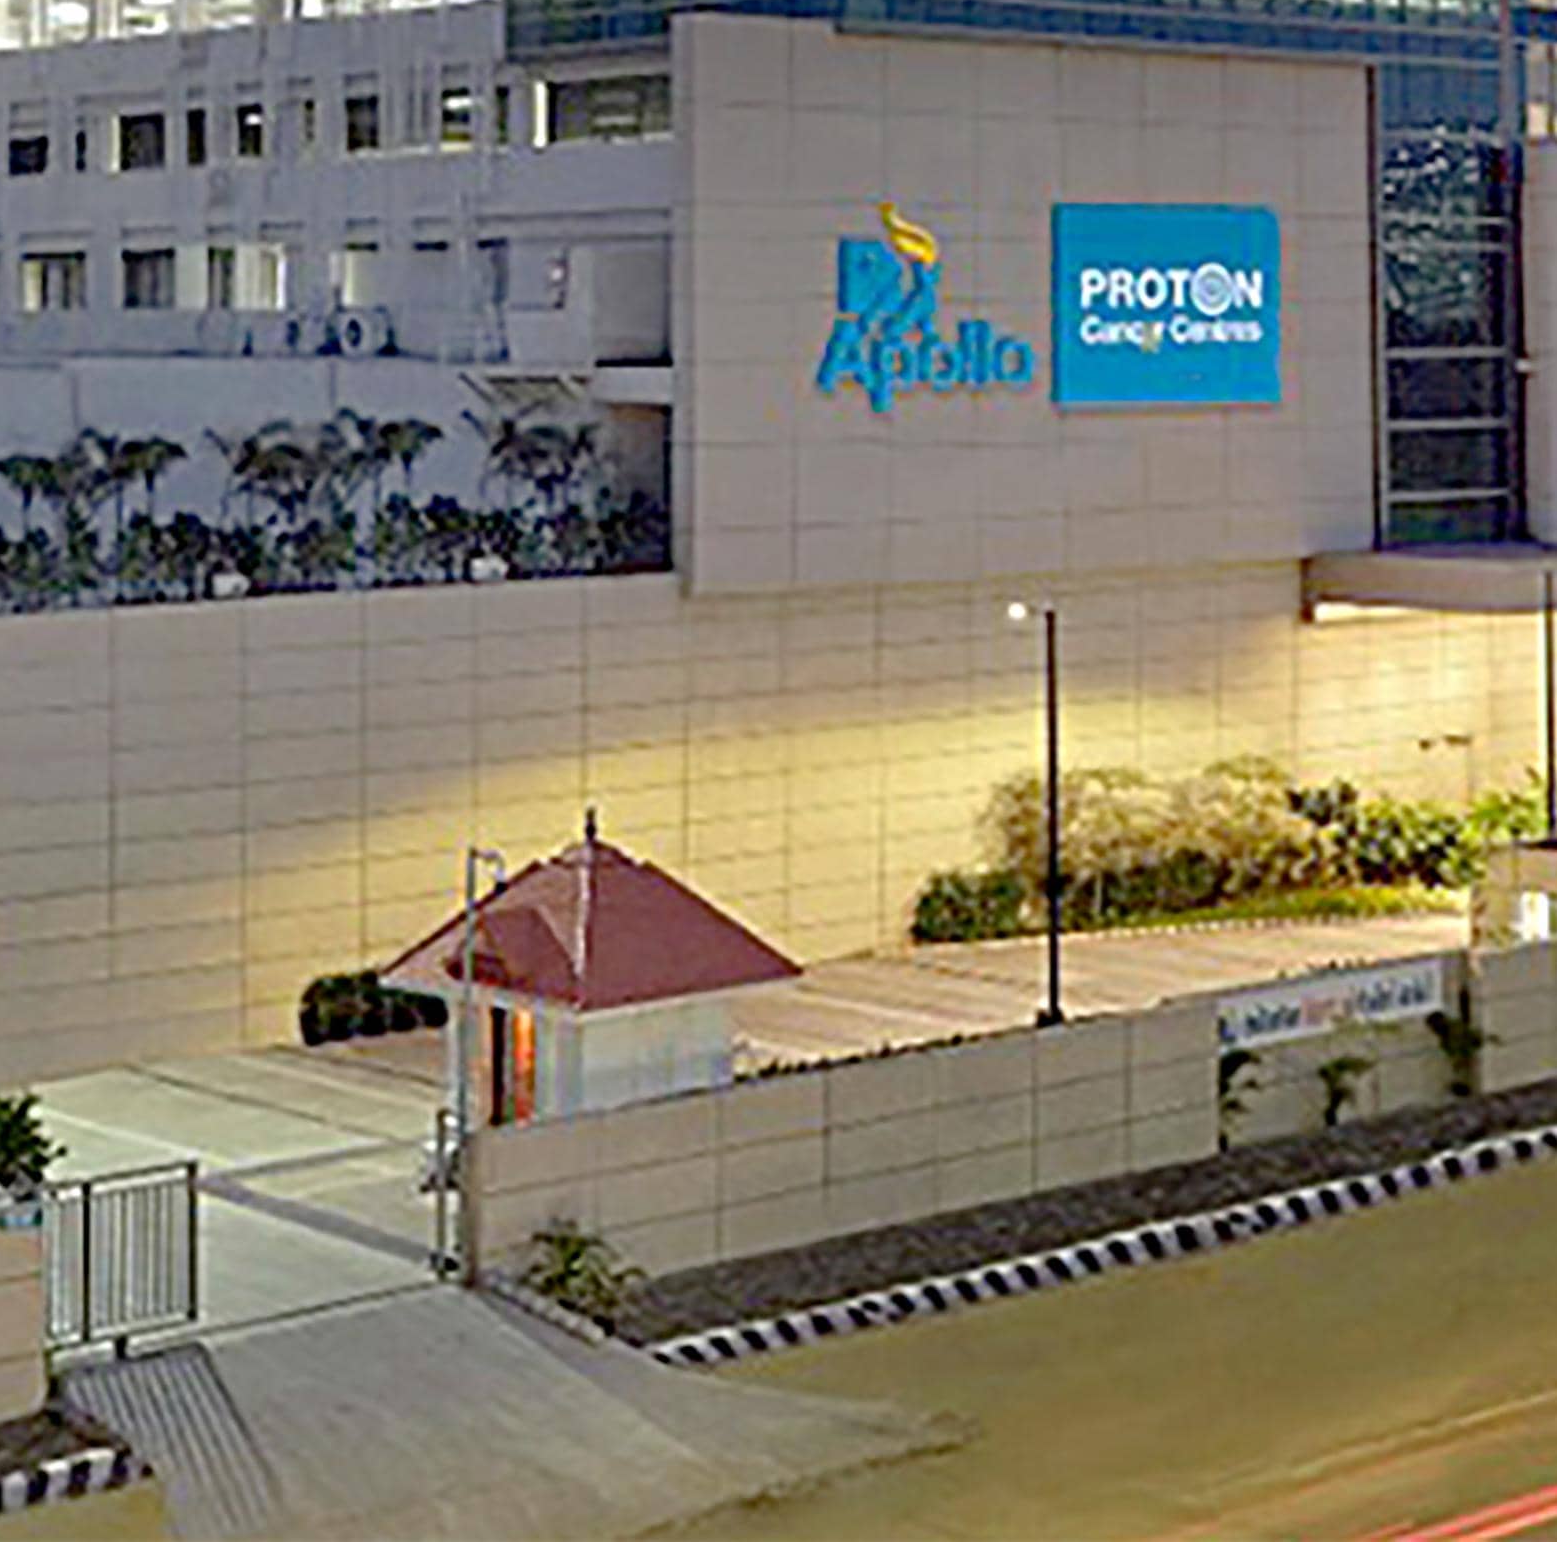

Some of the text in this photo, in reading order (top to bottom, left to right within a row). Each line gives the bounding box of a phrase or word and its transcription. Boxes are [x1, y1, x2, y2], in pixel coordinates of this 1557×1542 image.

[1080, 262, 1263, 316] PROTON
[1080, 315, 1164, 346] Cancr
[816, 317, 1033, 413] Apollo
